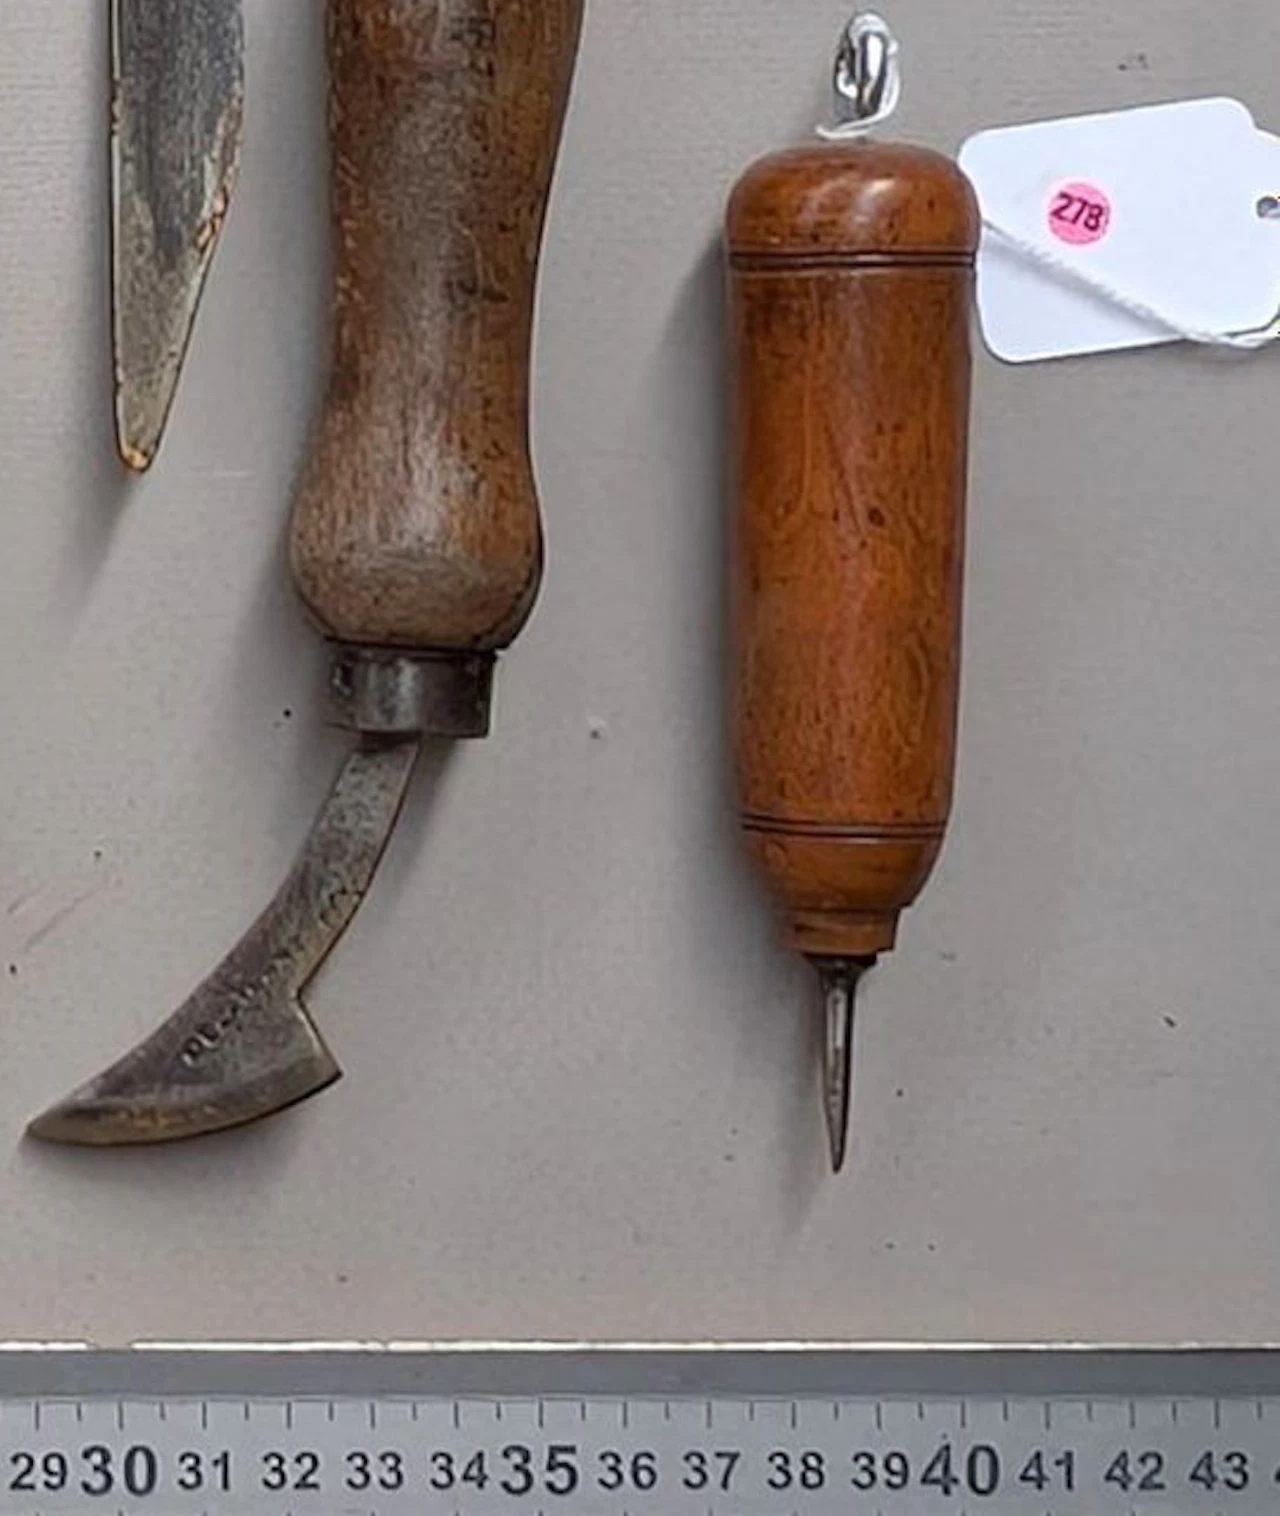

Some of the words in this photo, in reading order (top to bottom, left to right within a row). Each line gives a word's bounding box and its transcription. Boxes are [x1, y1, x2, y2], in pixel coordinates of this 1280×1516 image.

[1049, 191, 1105, 233] 278
[8, 1451, 68, 1492] 29
[80, 1444, 157, 1498] 30
[177, 1450, 230, 1492] 31
[261, 1451, 321, 1491] 32
[345, 1451, 404, 1491] 33
[429, 1450, 490, 1491] 34
[500, 1444, 579, 1497] 35
[597, 1450, 658, 1491] 36
[682, 1450, 741, 1491] 37
[766, 1451, 825, 1491] 38
[851, 1451, 910, 1491] 39
[919, 1443, 1000, 1497] 40
[1018, 1450, 1074, 1492] 41
[1103, 1450, 1166, 1492] 42
[1189, 1450, 1250, 1491] 43
